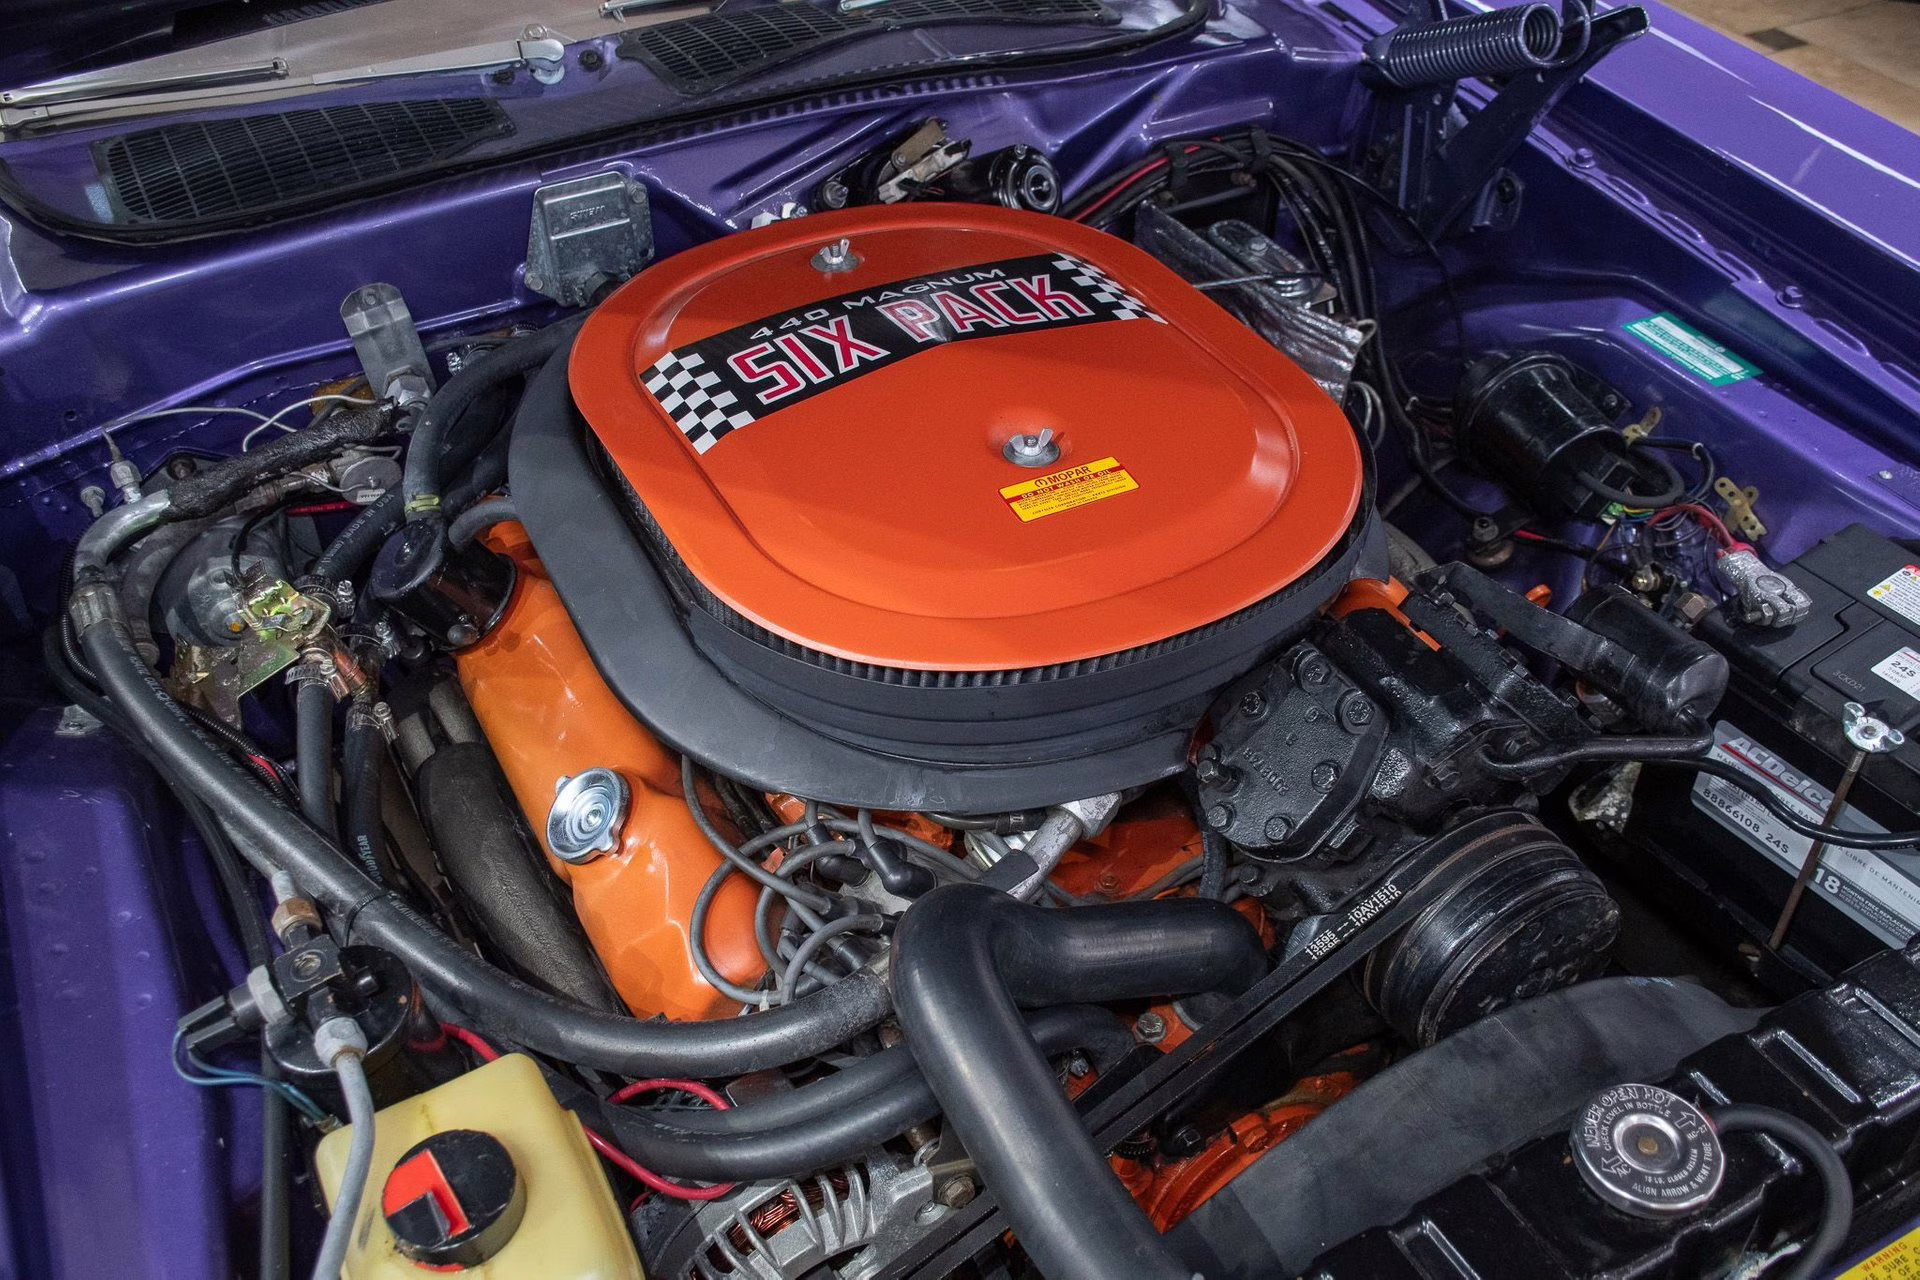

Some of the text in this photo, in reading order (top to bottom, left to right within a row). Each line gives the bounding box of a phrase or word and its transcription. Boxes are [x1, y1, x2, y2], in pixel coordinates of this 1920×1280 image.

[750, 269, 1006, 339] 440 MAGNUM
[727, 274, 1095, 405] SIX PACK
[1020, 491, 1034, 499] DO
[1036, 486, 1055, 496] NOT
[1056, 478, 1081, 491] WASH
[1097, 468, 1112, 477] OIL
[1048, 465, 1092, 485] MOPAR
[343, 493, 395, 539] MADE IN USA
[1891, 661, 1916, 677] 24S
[1703, 788, 1760, 833] 88866108
[1765, 832, 1790, 854] 24S
[1814, 868, 1841, 894] 18
[1305, 884, 1397, 956] 13595 10AV1510
[1584, 1087, 1676, 1147] NEVER OPEN HOT
[1601, 1102, 1671, 1151] CHECK LEVEL IN BOTTLE
[1702, 1142, 1712, 1161] TUBE
[1615, 1163, 1631, 1178] AC
[1695, 1163, 1711, 1183] VENT
[1632, 1182, 1657, 1196] ALIGN
[1661, 1184, 1689, 1197] ARROW
[1862, 1242, 1907, 1272] WARNING
[1883, 1254, 1909, 1273] SURE
